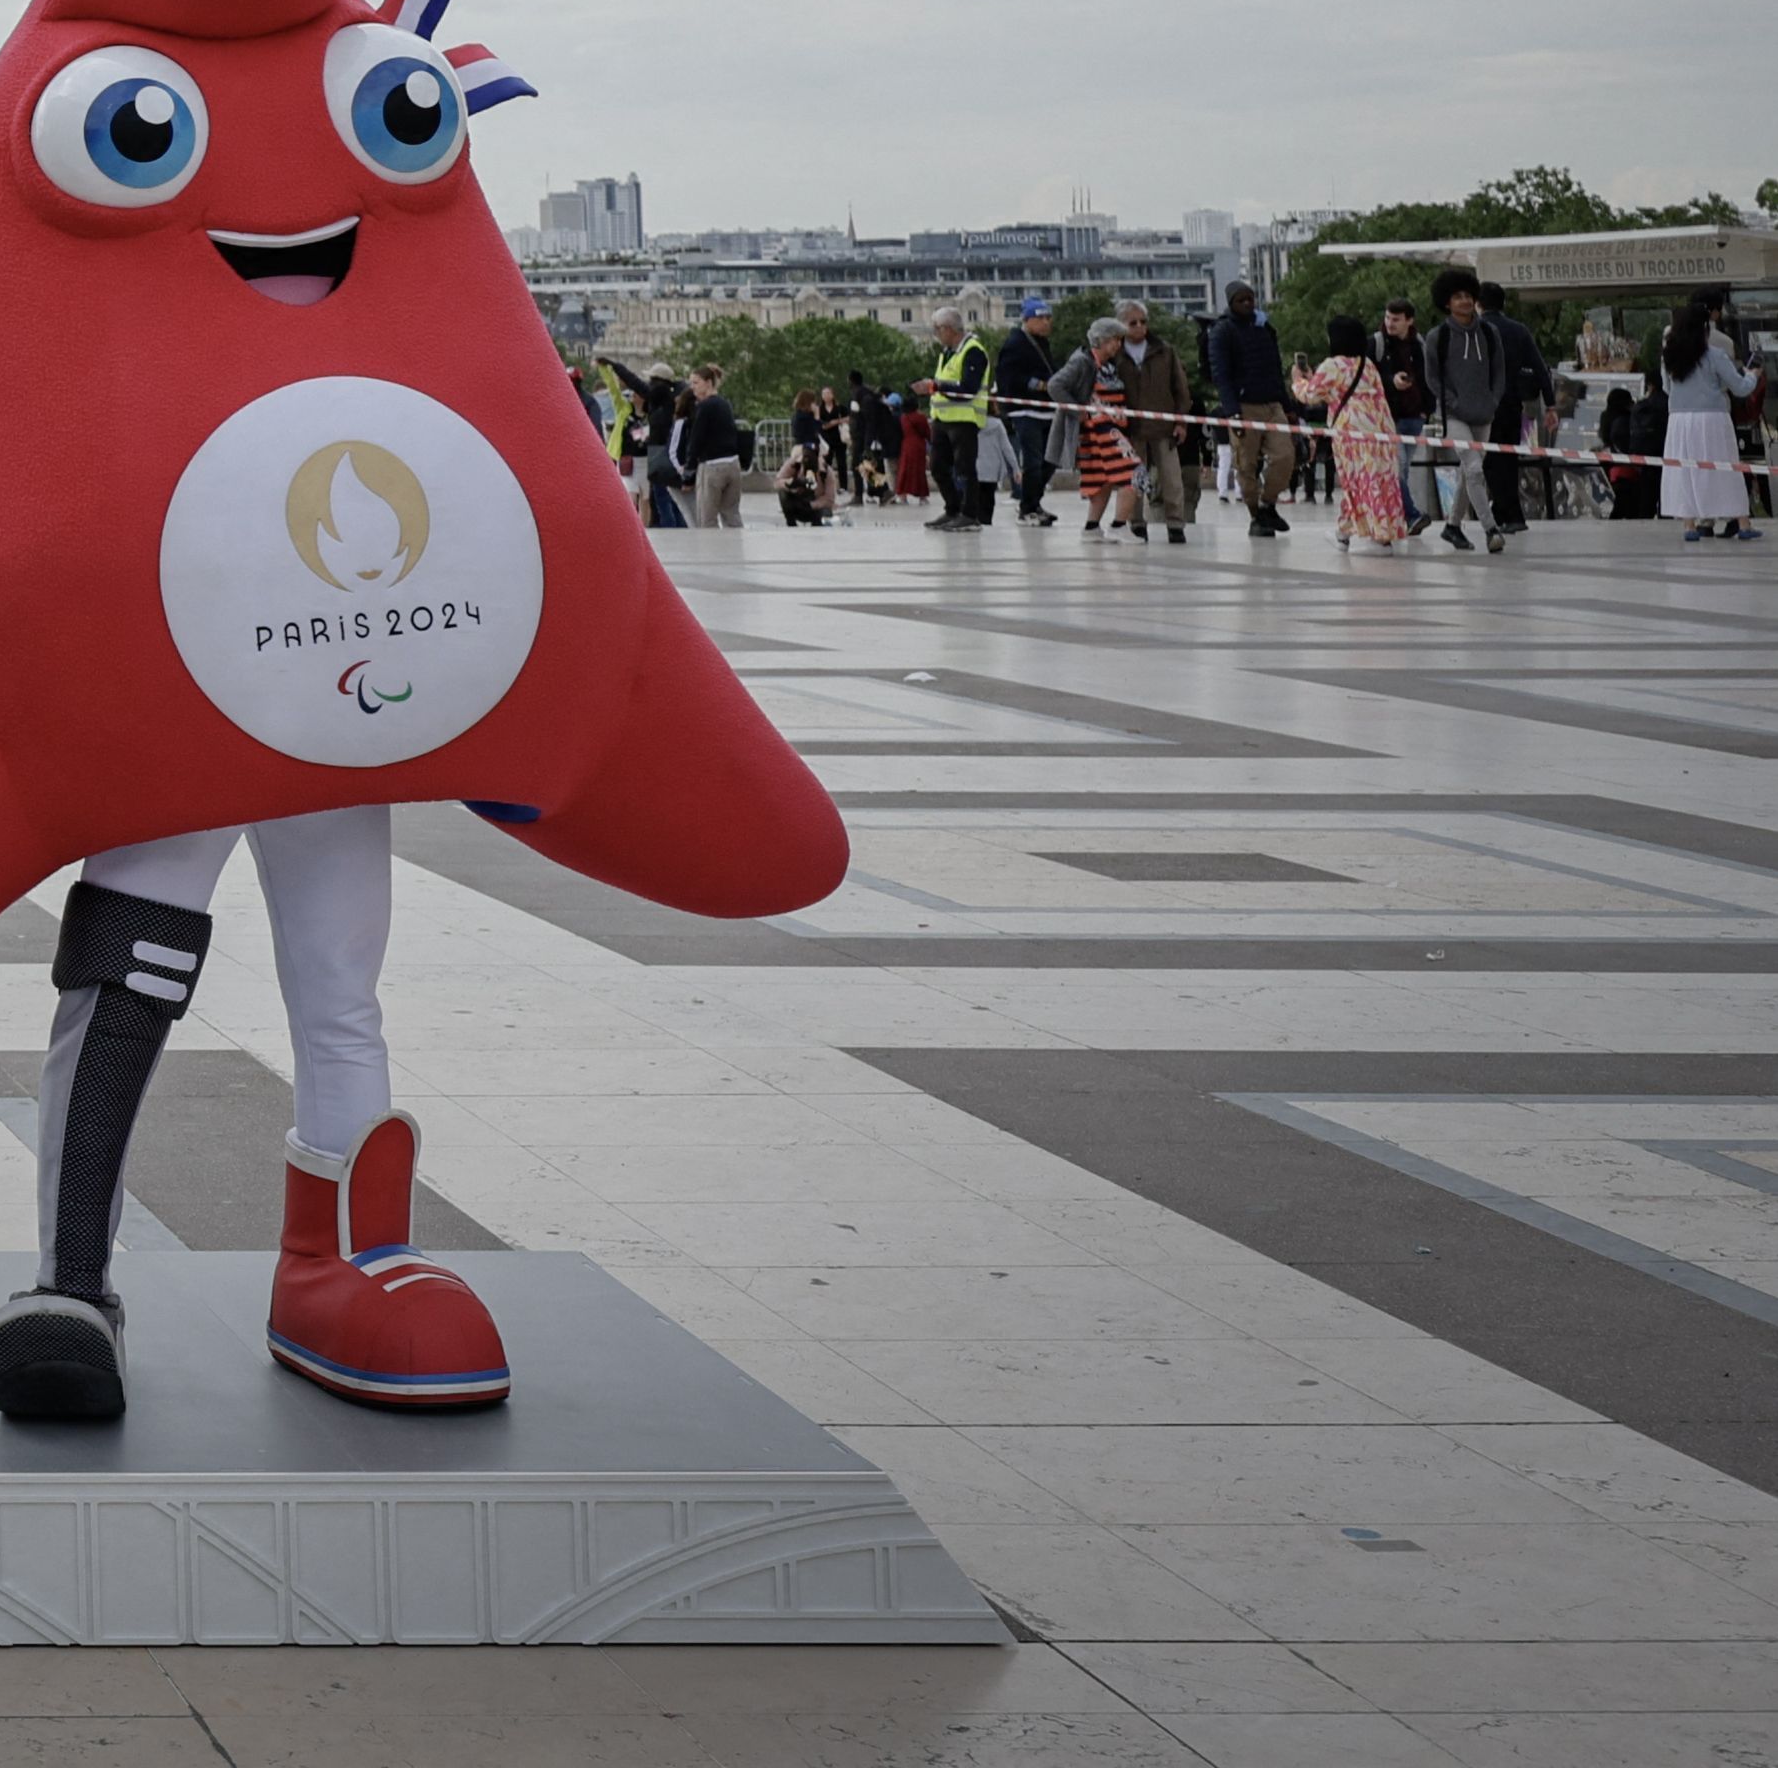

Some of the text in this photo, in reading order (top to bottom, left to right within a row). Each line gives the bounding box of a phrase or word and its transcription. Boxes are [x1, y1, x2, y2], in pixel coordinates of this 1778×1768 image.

[1510, 257, 1726, 281] LES TERRASSES DU TROCADERO
[385, 600, 482, 637] 2024
